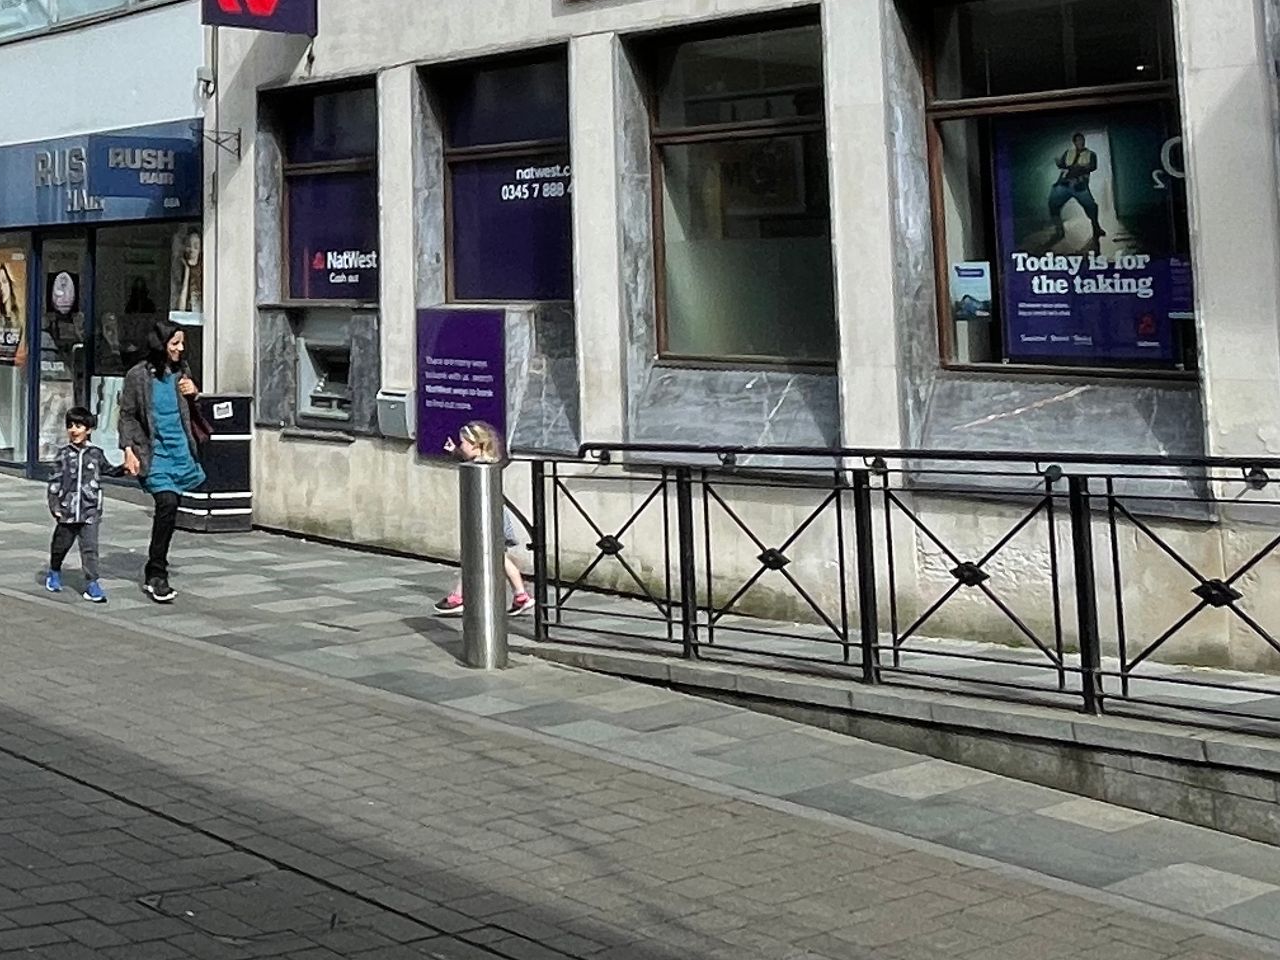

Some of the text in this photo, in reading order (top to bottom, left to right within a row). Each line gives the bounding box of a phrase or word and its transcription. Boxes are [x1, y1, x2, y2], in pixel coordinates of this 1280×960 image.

[108, 147, 174, 170] RUSH
[501, 184, 529, 200] 0345
[531, 183, 539, 198] 7
[327, 250, 377, 270] NatWest
[1012, 251, 1083, 275] Today
[1087, 251, 1108, 271] is
[1114, 249, 1151, 271] for
[1031, 273, 1154, 299] the taking
